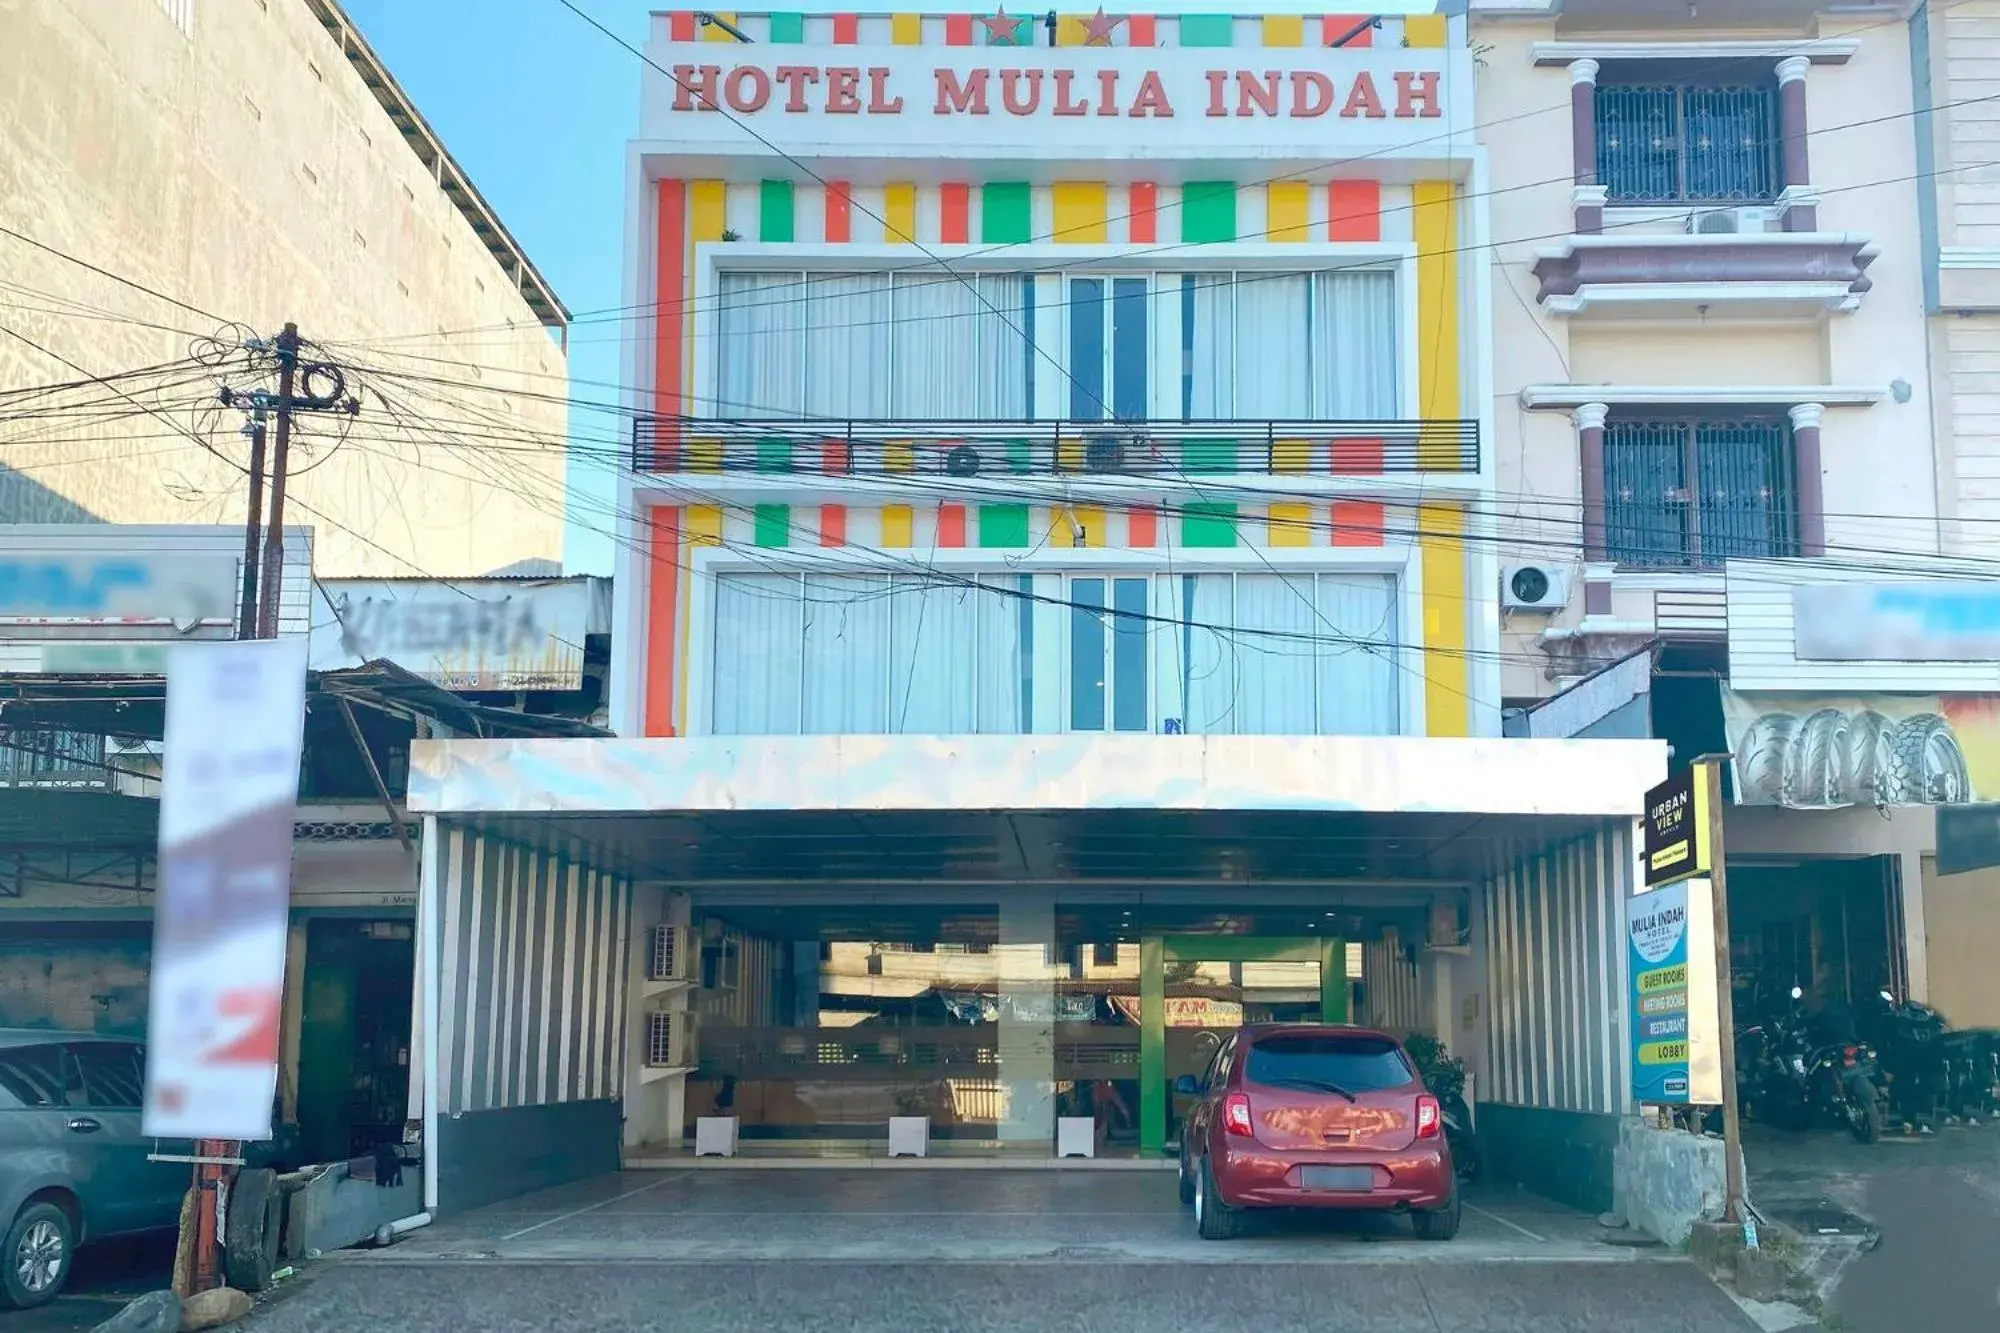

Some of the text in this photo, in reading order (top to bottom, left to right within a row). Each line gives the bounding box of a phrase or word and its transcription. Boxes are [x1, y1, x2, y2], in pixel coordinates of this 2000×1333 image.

[671, 64, 1442, 119] HOTEL MULIA INDAH
[1652, 790, 1687, 819] URBAN
[1656, 807, 1683, 831] VIEW
[1632, 906, 1684, 934] MULIA INDAH
[1647, 927, 1669, 937] HOTEL
[1644, 967, 1685, 988] GUEST ROOMS
[1665, 992, 1685, 1008] ROOMS
[1650, 1018, 1685, 1035] RESTAURANT
[1658, 1046, 1684, 1059] LOBBY
